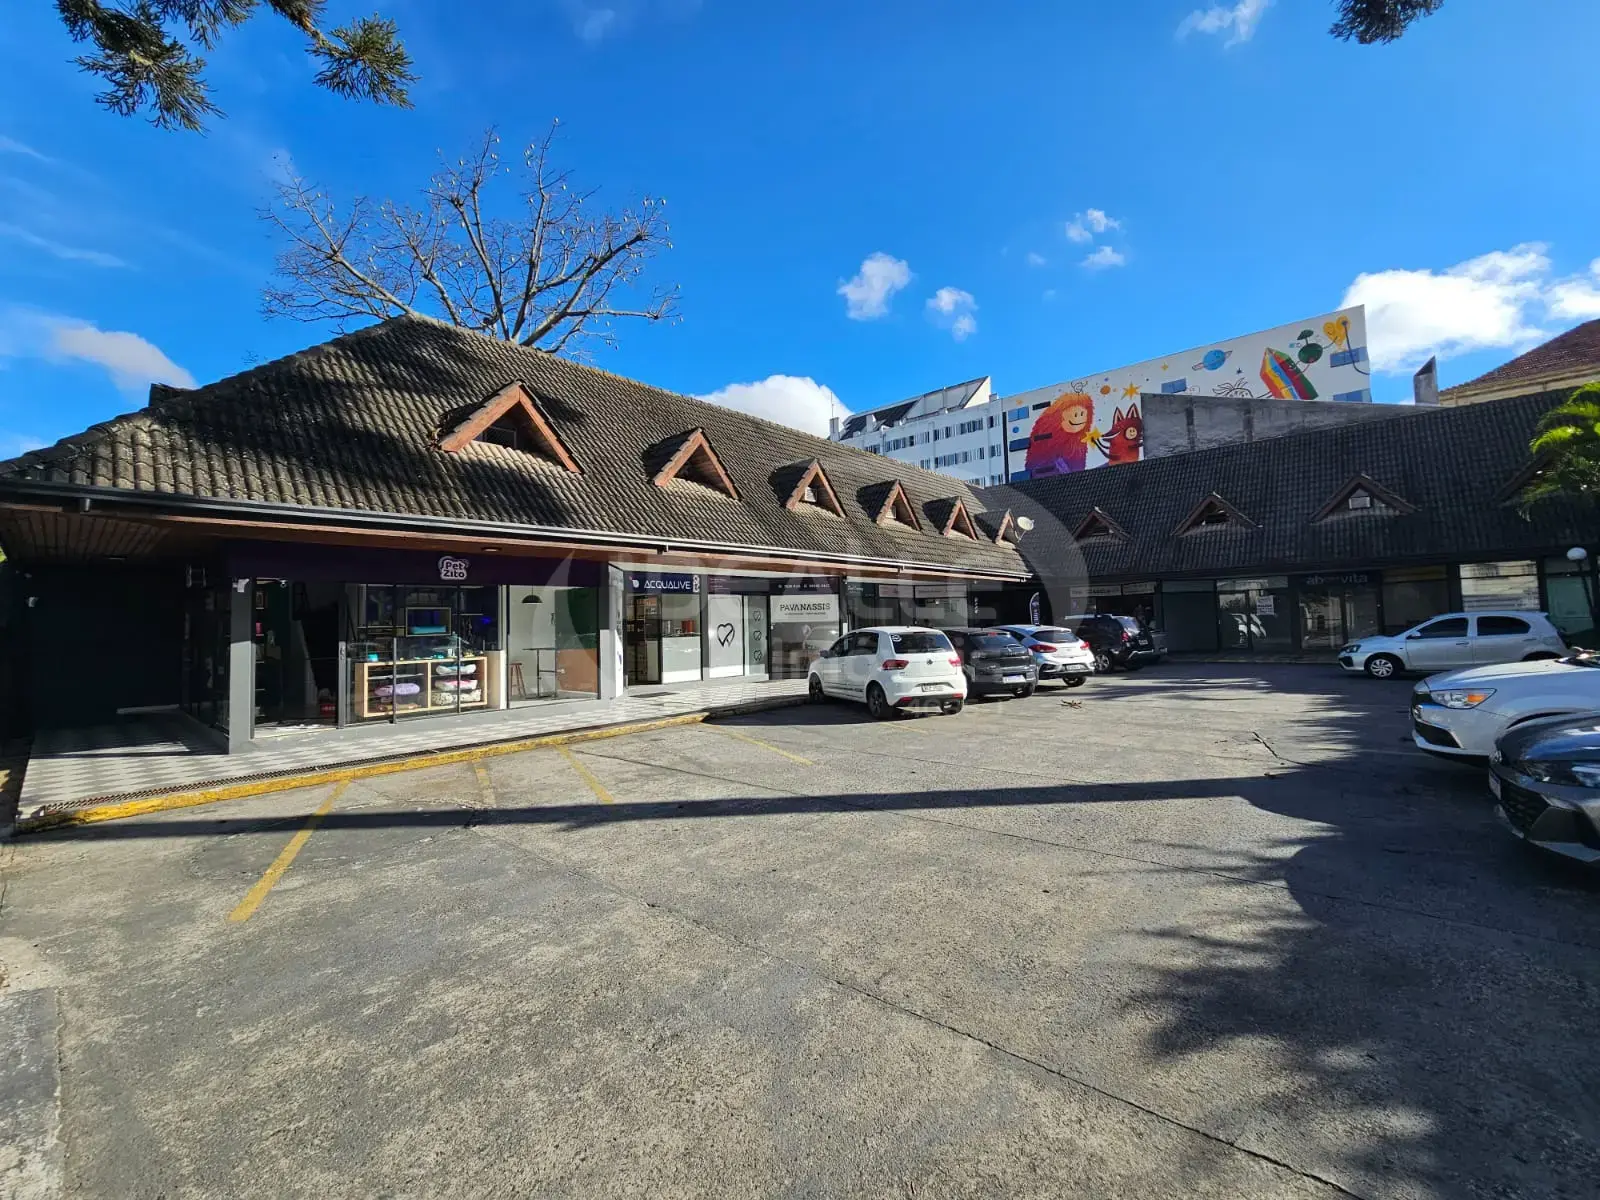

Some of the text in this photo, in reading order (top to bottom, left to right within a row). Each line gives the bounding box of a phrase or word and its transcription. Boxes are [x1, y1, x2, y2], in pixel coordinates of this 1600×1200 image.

[445, 561, 465, 569] Pet
[443, 570, 465, 578] Zito
[643, 580, 691, 590] ACQUALIVE
[780, 602, 831, 611] PAVANASSIS
